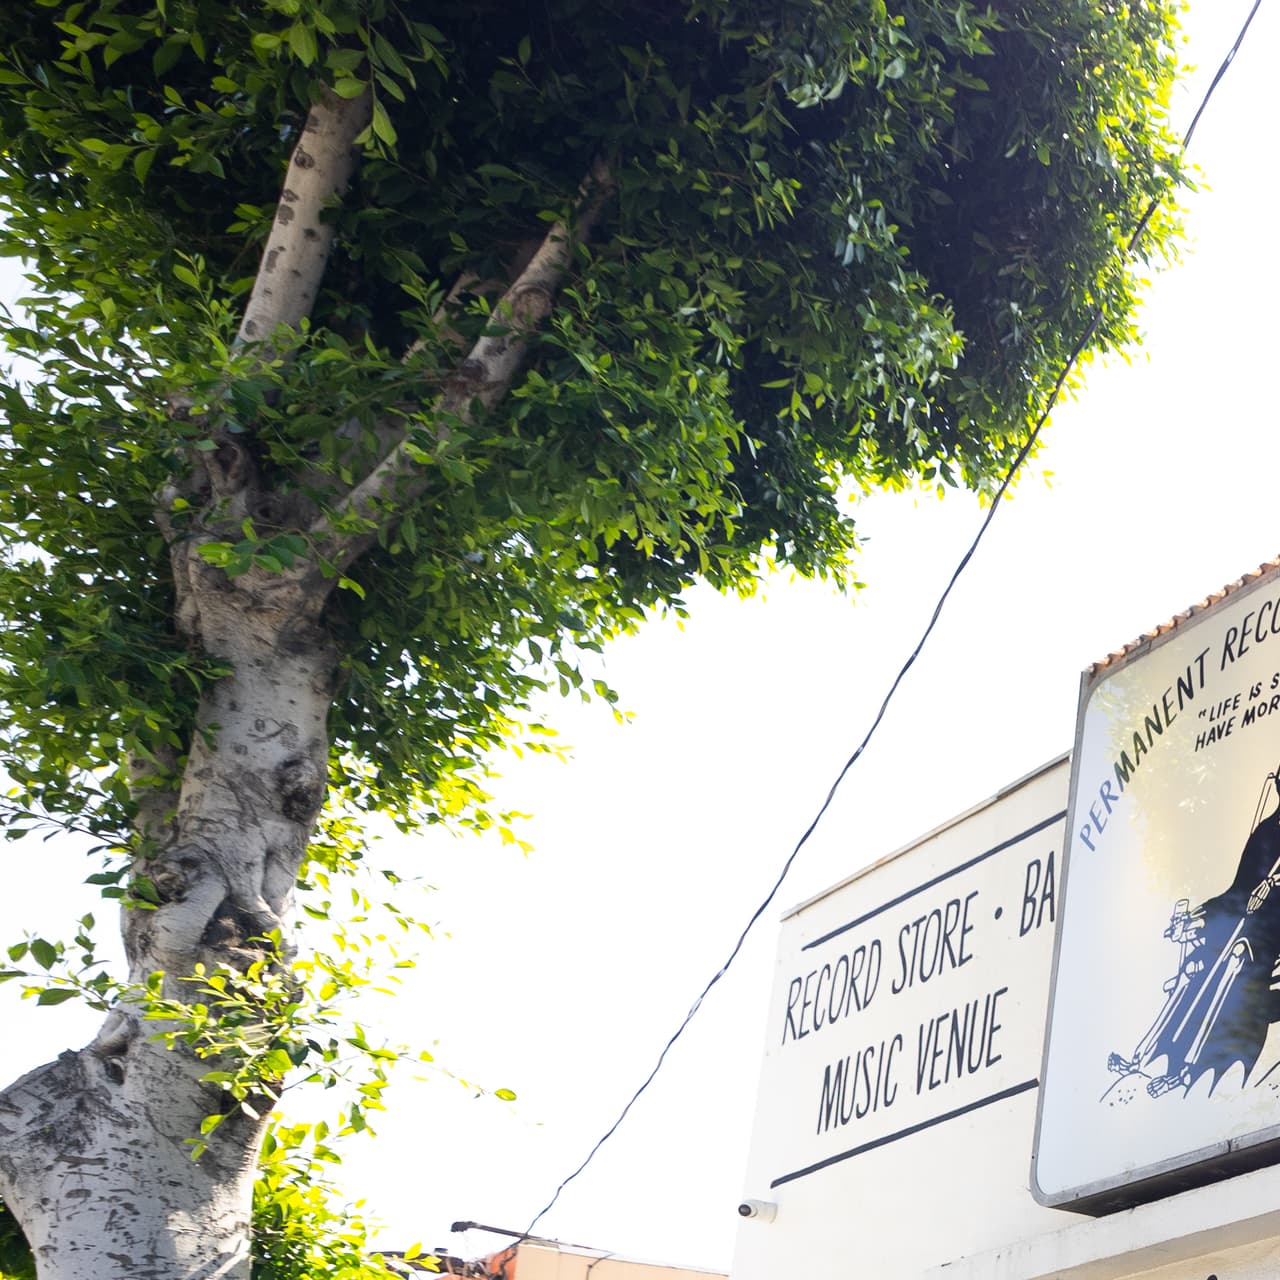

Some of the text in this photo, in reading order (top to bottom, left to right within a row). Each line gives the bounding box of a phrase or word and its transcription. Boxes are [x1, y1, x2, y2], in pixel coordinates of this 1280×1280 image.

[1079, 647, 1211, 853] PERMANENT
[1194, 716, 1237, 752] HAVE
[1248, 681, 1263, 702] IS
[781, 850, 1056, 1046] RECORD STORE BA
[816, 986, 1009, 1136] MUSIC VENUE
